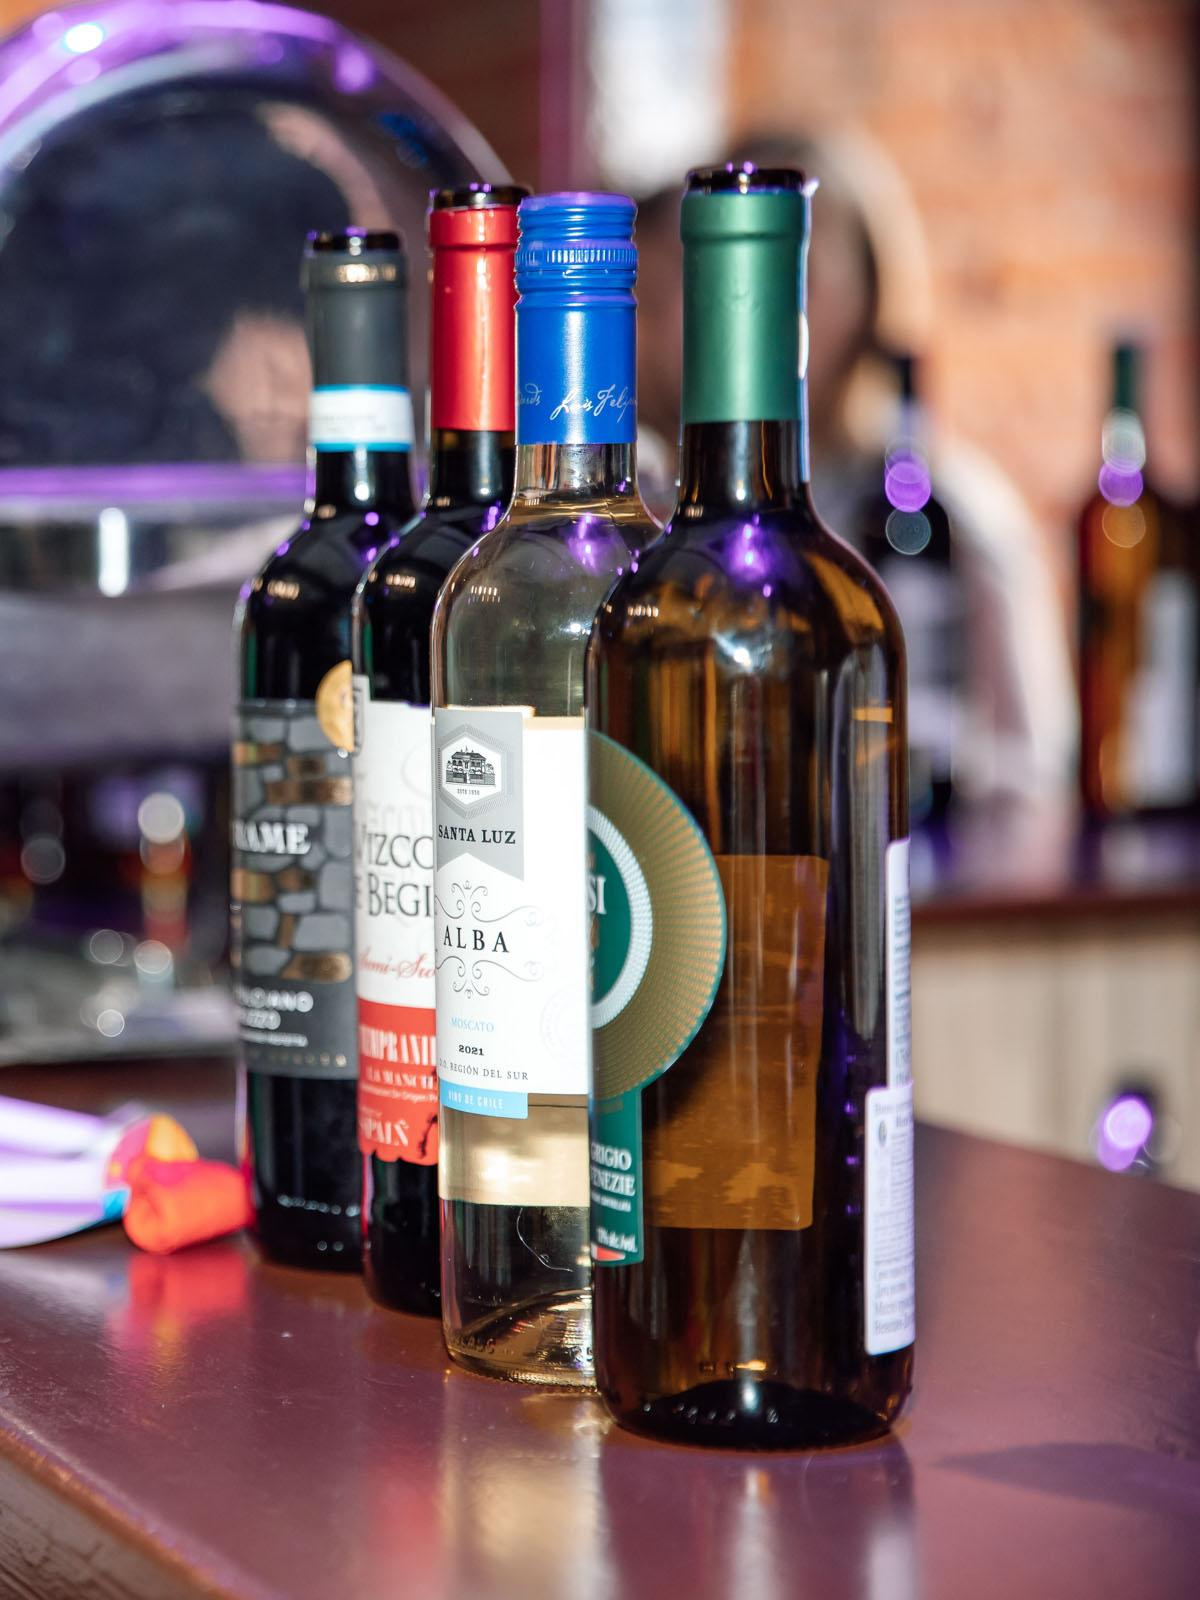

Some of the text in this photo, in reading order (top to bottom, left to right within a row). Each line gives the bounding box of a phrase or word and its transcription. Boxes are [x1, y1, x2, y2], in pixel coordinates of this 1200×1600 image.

[438, 824, 516, 845] SANTA LUZ
[443, 925, 510, 953] ALBA
[451, 1016, 495, 1033] MOSCATO
[458, 1044, 485, 1056] 2021
[450, 1061, 479, 1077] REGIÓN
[483, 1068, 503, 1079] DEL
[507, 1071, 529, 1081] SUR
[448, 1089, 503, 1110] VINO DE CHILE
